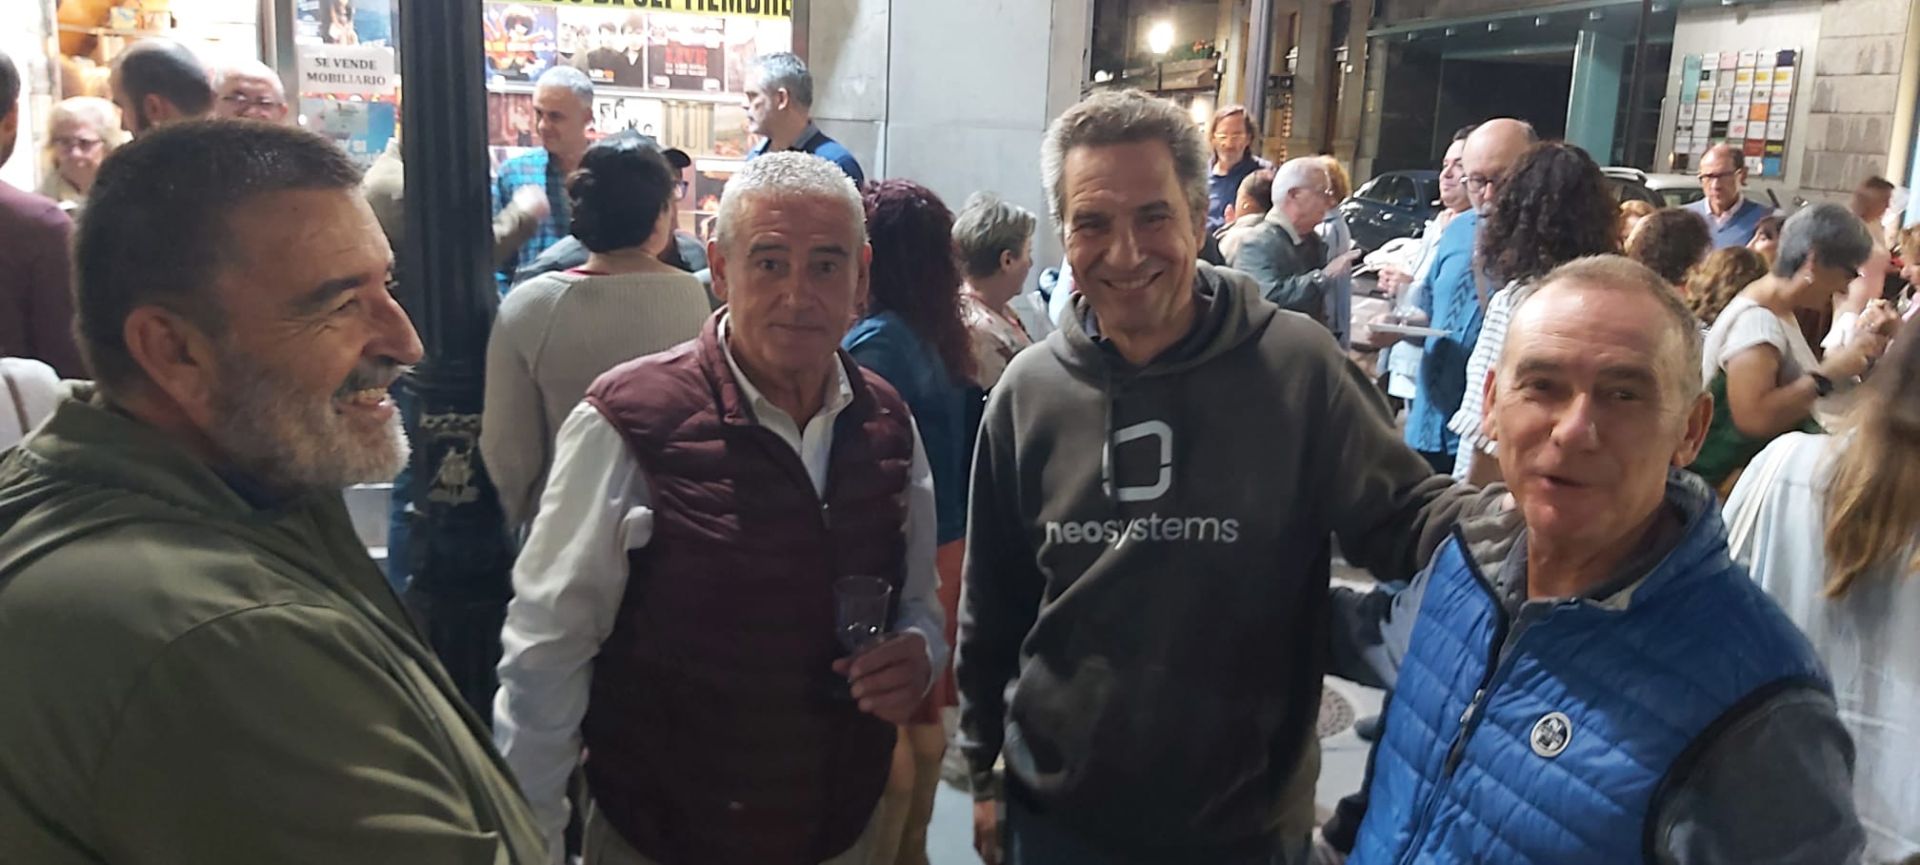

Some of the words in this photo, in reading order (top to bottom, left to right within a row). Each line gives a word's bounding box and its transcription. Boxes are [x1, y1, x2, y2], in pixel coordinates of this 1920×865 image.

[315, 57, 330, 69] SE
[333, 58, 378, 71] VENDE
[306, 72, 387, 86] MOBILIARIO
[1045, 512, 1240, 550] neosystems
